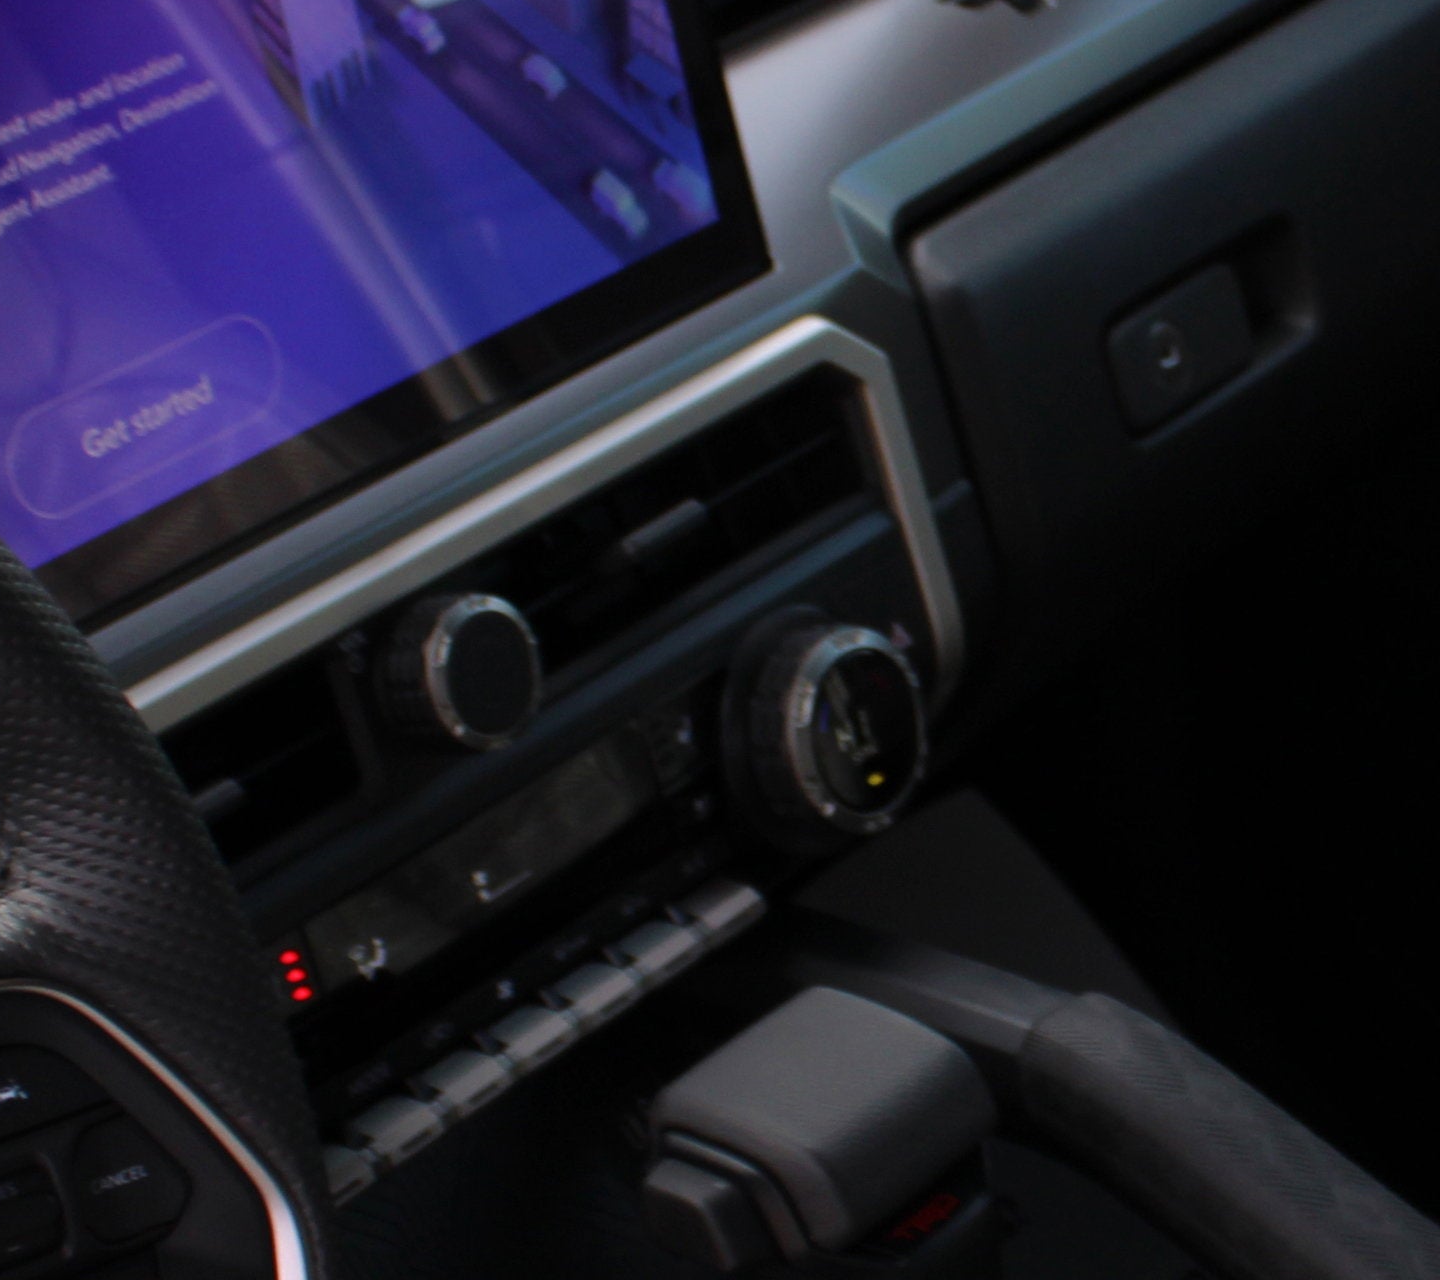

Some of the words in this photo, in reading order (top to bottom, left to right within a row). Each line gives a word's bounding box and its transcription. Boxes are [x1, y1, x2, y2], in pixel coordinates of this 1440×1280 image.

[25, 96, 78, 130] route
[76, 75, 116, 110] and
[111, 52, 188, 95] location
[117, 77, 223, 133] Destination
[80, 418, 130, 458] Get
[128, 373, 216, 437] started
[89, 1163, 149, 1196] CANCEL
